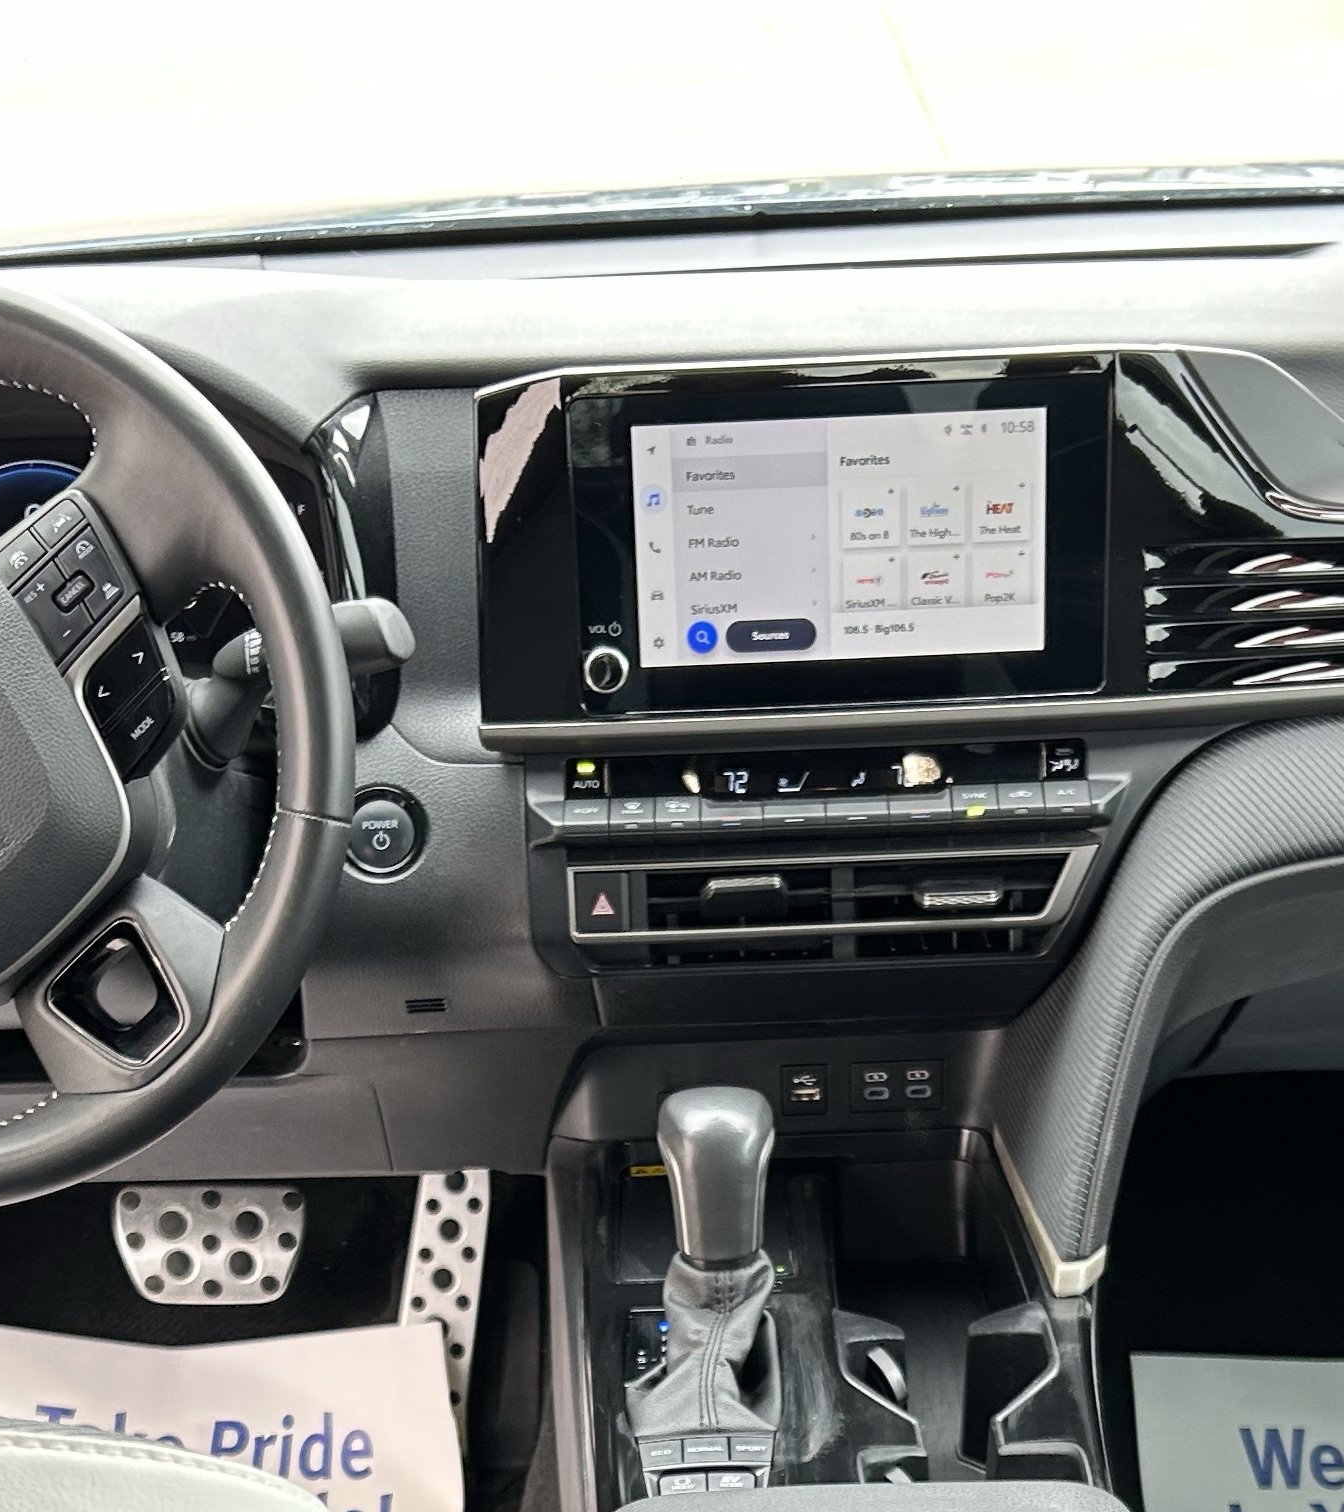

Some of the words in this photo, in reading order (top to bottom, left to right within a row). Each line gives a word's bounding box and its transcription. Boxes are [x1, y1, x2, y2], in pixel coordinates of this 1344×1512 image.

[1001, 421, 1035, 433] 10:58
[705, 435, 734, 445] Radio
[840, 455, 890, 467] Favorites
[686, 470, 736, 482] Favorites
[686, 505, 715, 516] Tune
[910, 529, 927, 538] The
[979, 526, 997, 535] The
[999, 525, 1022, 534] Heat
[688, 538, 705, 549] FM
[707, 537, 740, 548] Radio
[689, 572, 708, 582] AM
[710, 570, 742, 581] Radio
[690, 603, 738, 615] SiriusXM
[587, 625, 607, 634] VOL
[129, 716, 156, 741] MODE
[572, 780, 601, 789] AUTO
[722, 771, 750, 794] 72
[961, 791, 988, 800] SYNC
[361, 819, 399, 831] POWER
[210, 1412, 374, 1481] Pride
